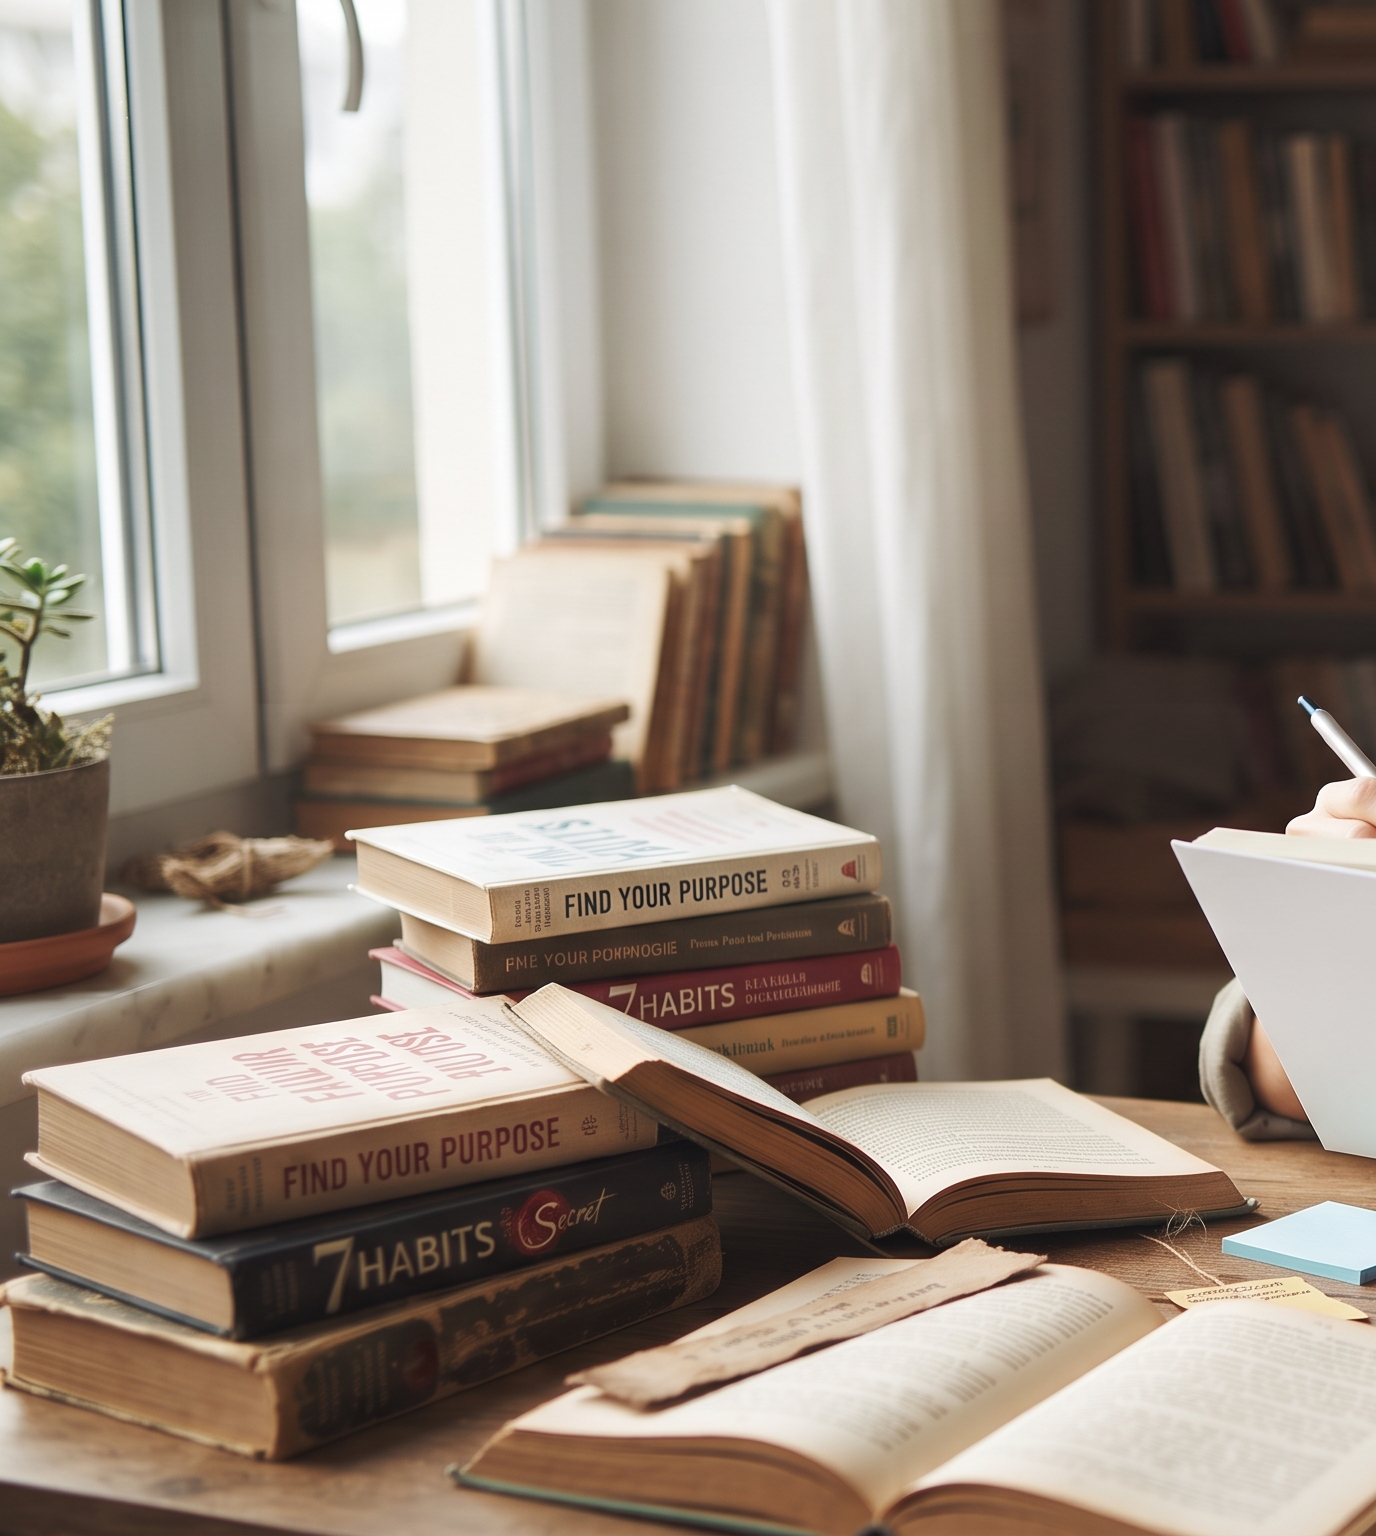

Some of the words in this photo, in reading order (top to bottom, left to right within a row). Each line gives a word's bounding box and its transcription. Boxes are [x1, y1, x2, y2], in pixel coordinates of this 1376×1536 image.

[565, 889, 612, 919] FIND
[618, 881, 672, 911] YOUR
[680, 869, 769, 903] PURPOSE
[544, 947, 588, 967] YOUR
[283, 1155, 348, 1199] FIND
[358, 1142, 431, 1182] YOUR
[441, 1116, 561, 1169] PURPOSE
[518, 1187, 619, 1249] Secret
